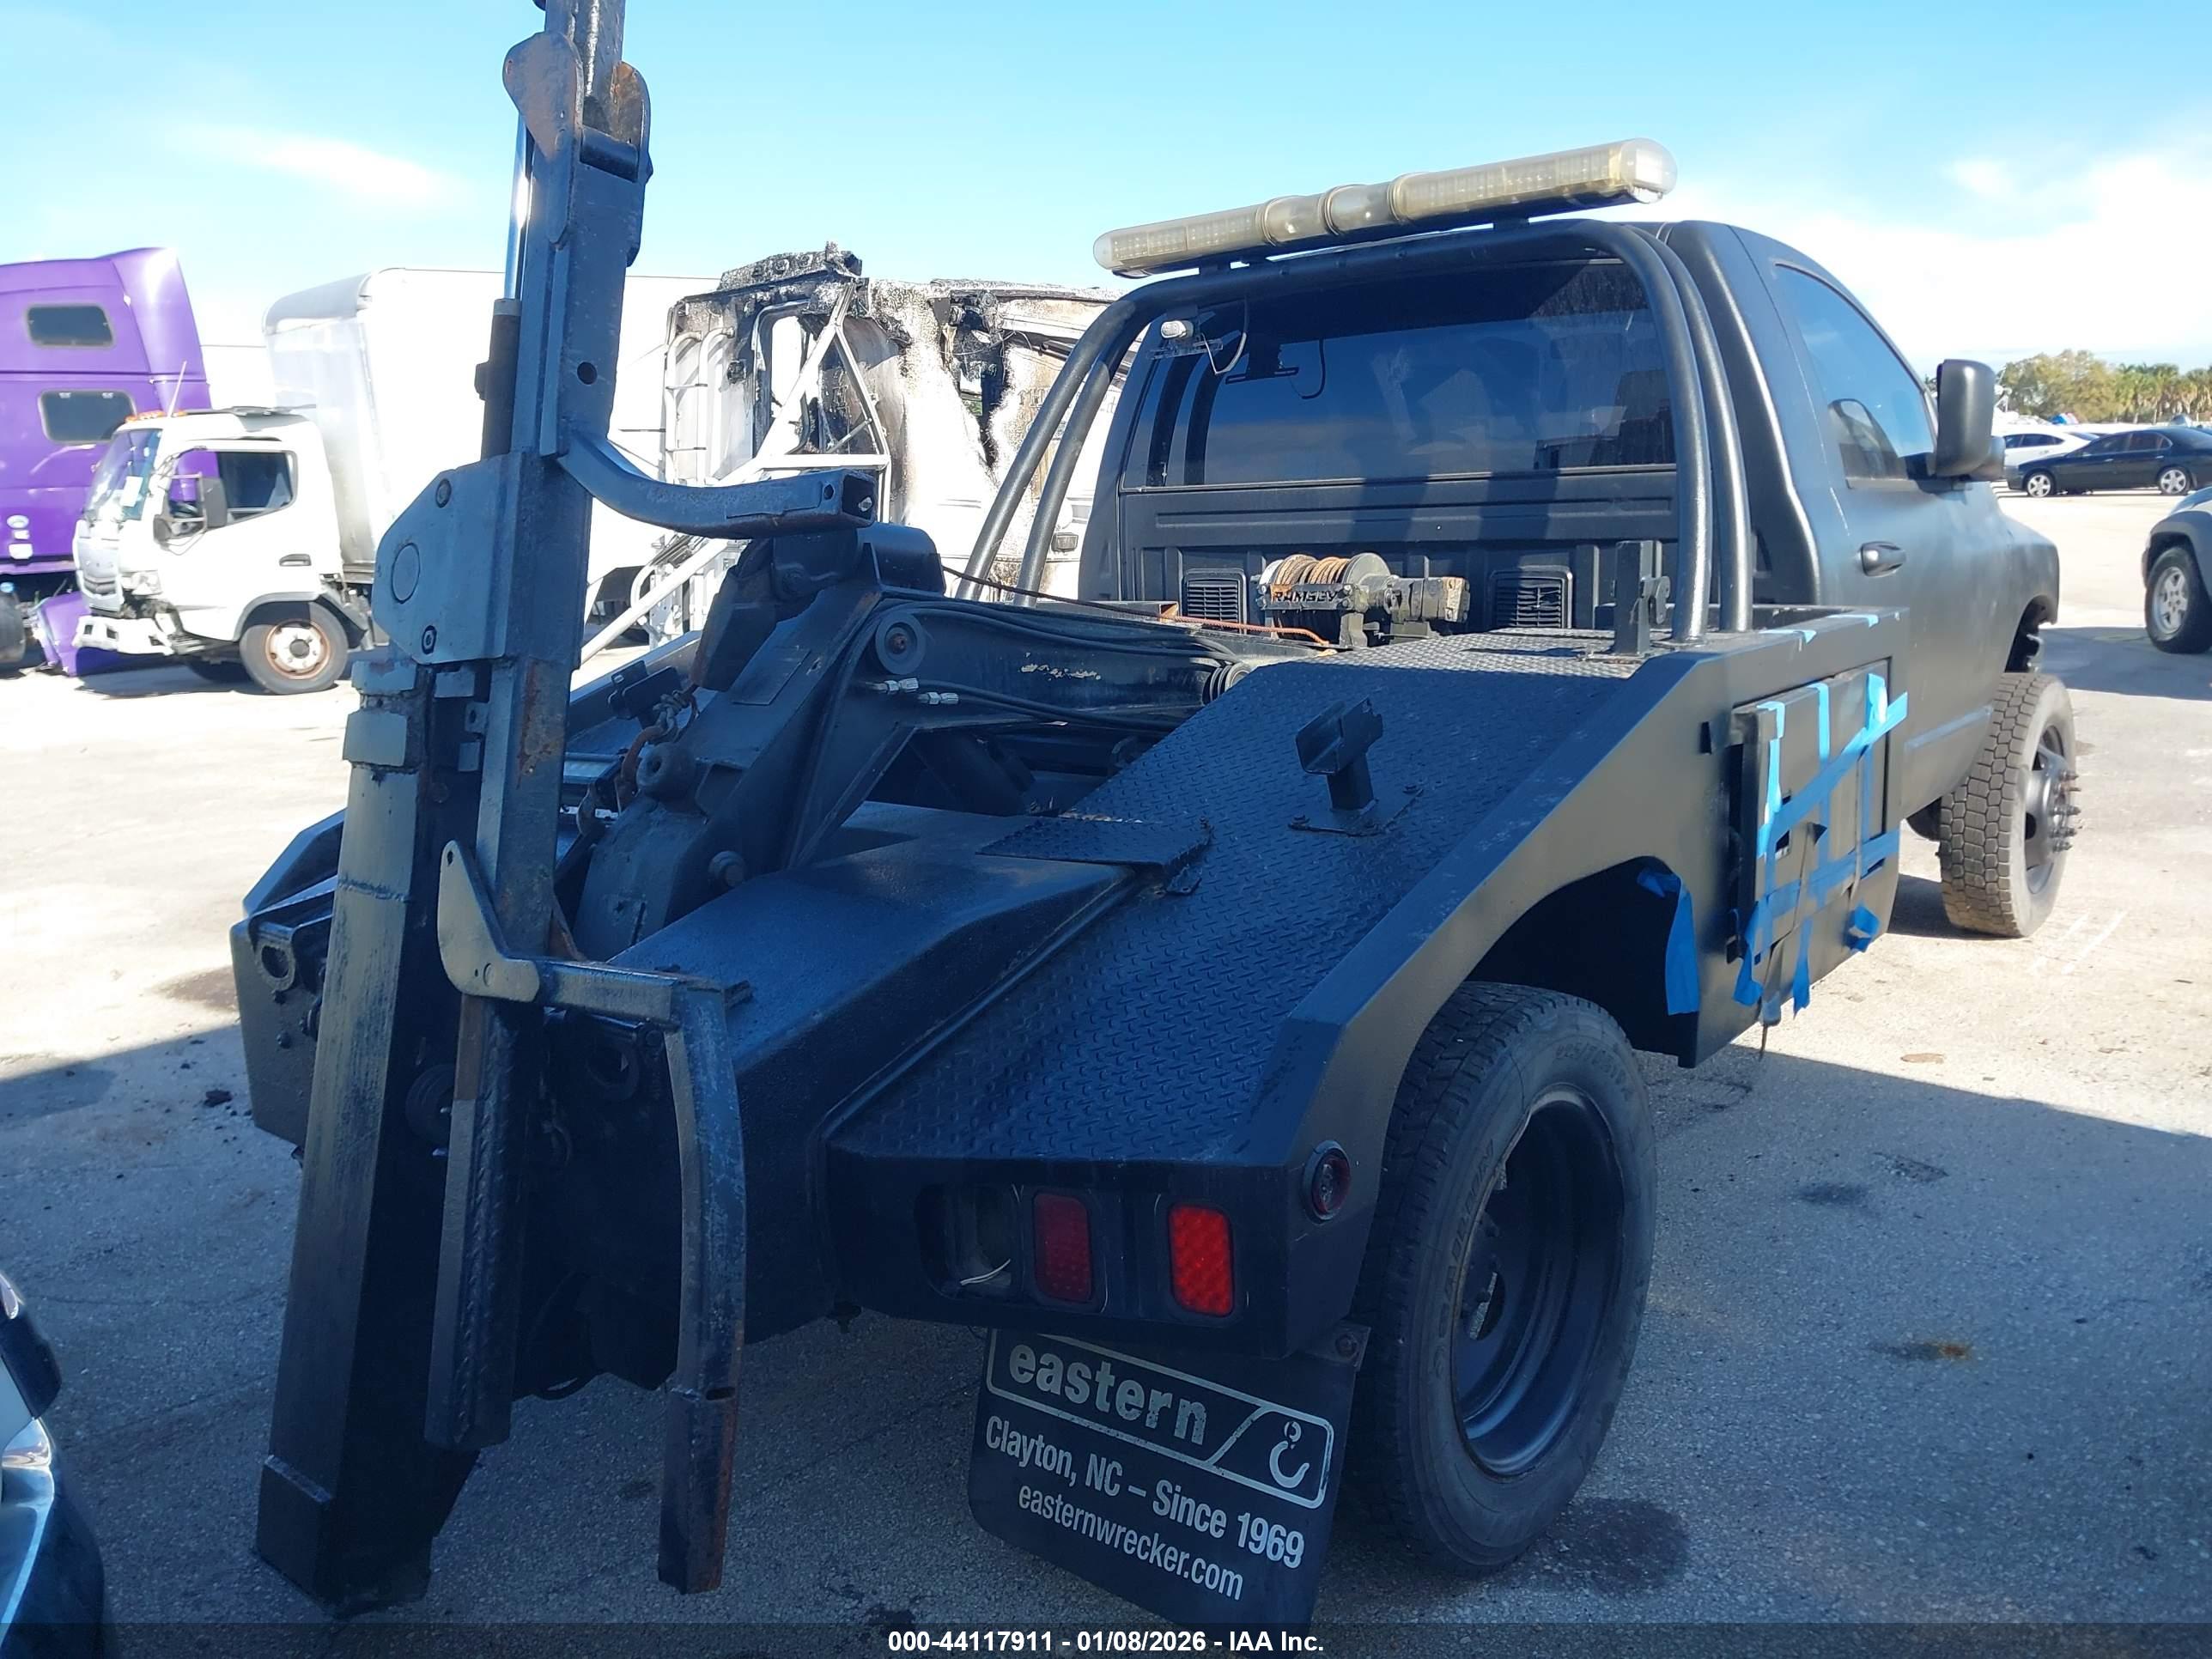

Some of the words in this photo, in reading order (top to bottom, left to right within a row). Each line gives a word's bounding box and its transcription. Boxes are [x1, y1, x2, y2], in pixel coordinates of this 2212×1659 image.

[1273, 590, 1337, 602] RAMSEY
[1009, 1343, 1207, 1445] eastern
[986, 1416, 1078, 1487] Clayton,
[1085, 1453, 1123, 1497] NC
[1152, 1480, 1227, 1539] Since
[1237, 1512, 1304, 1570] 1969
[1018, 1485, 1244, 1601] easternwrecker.com
